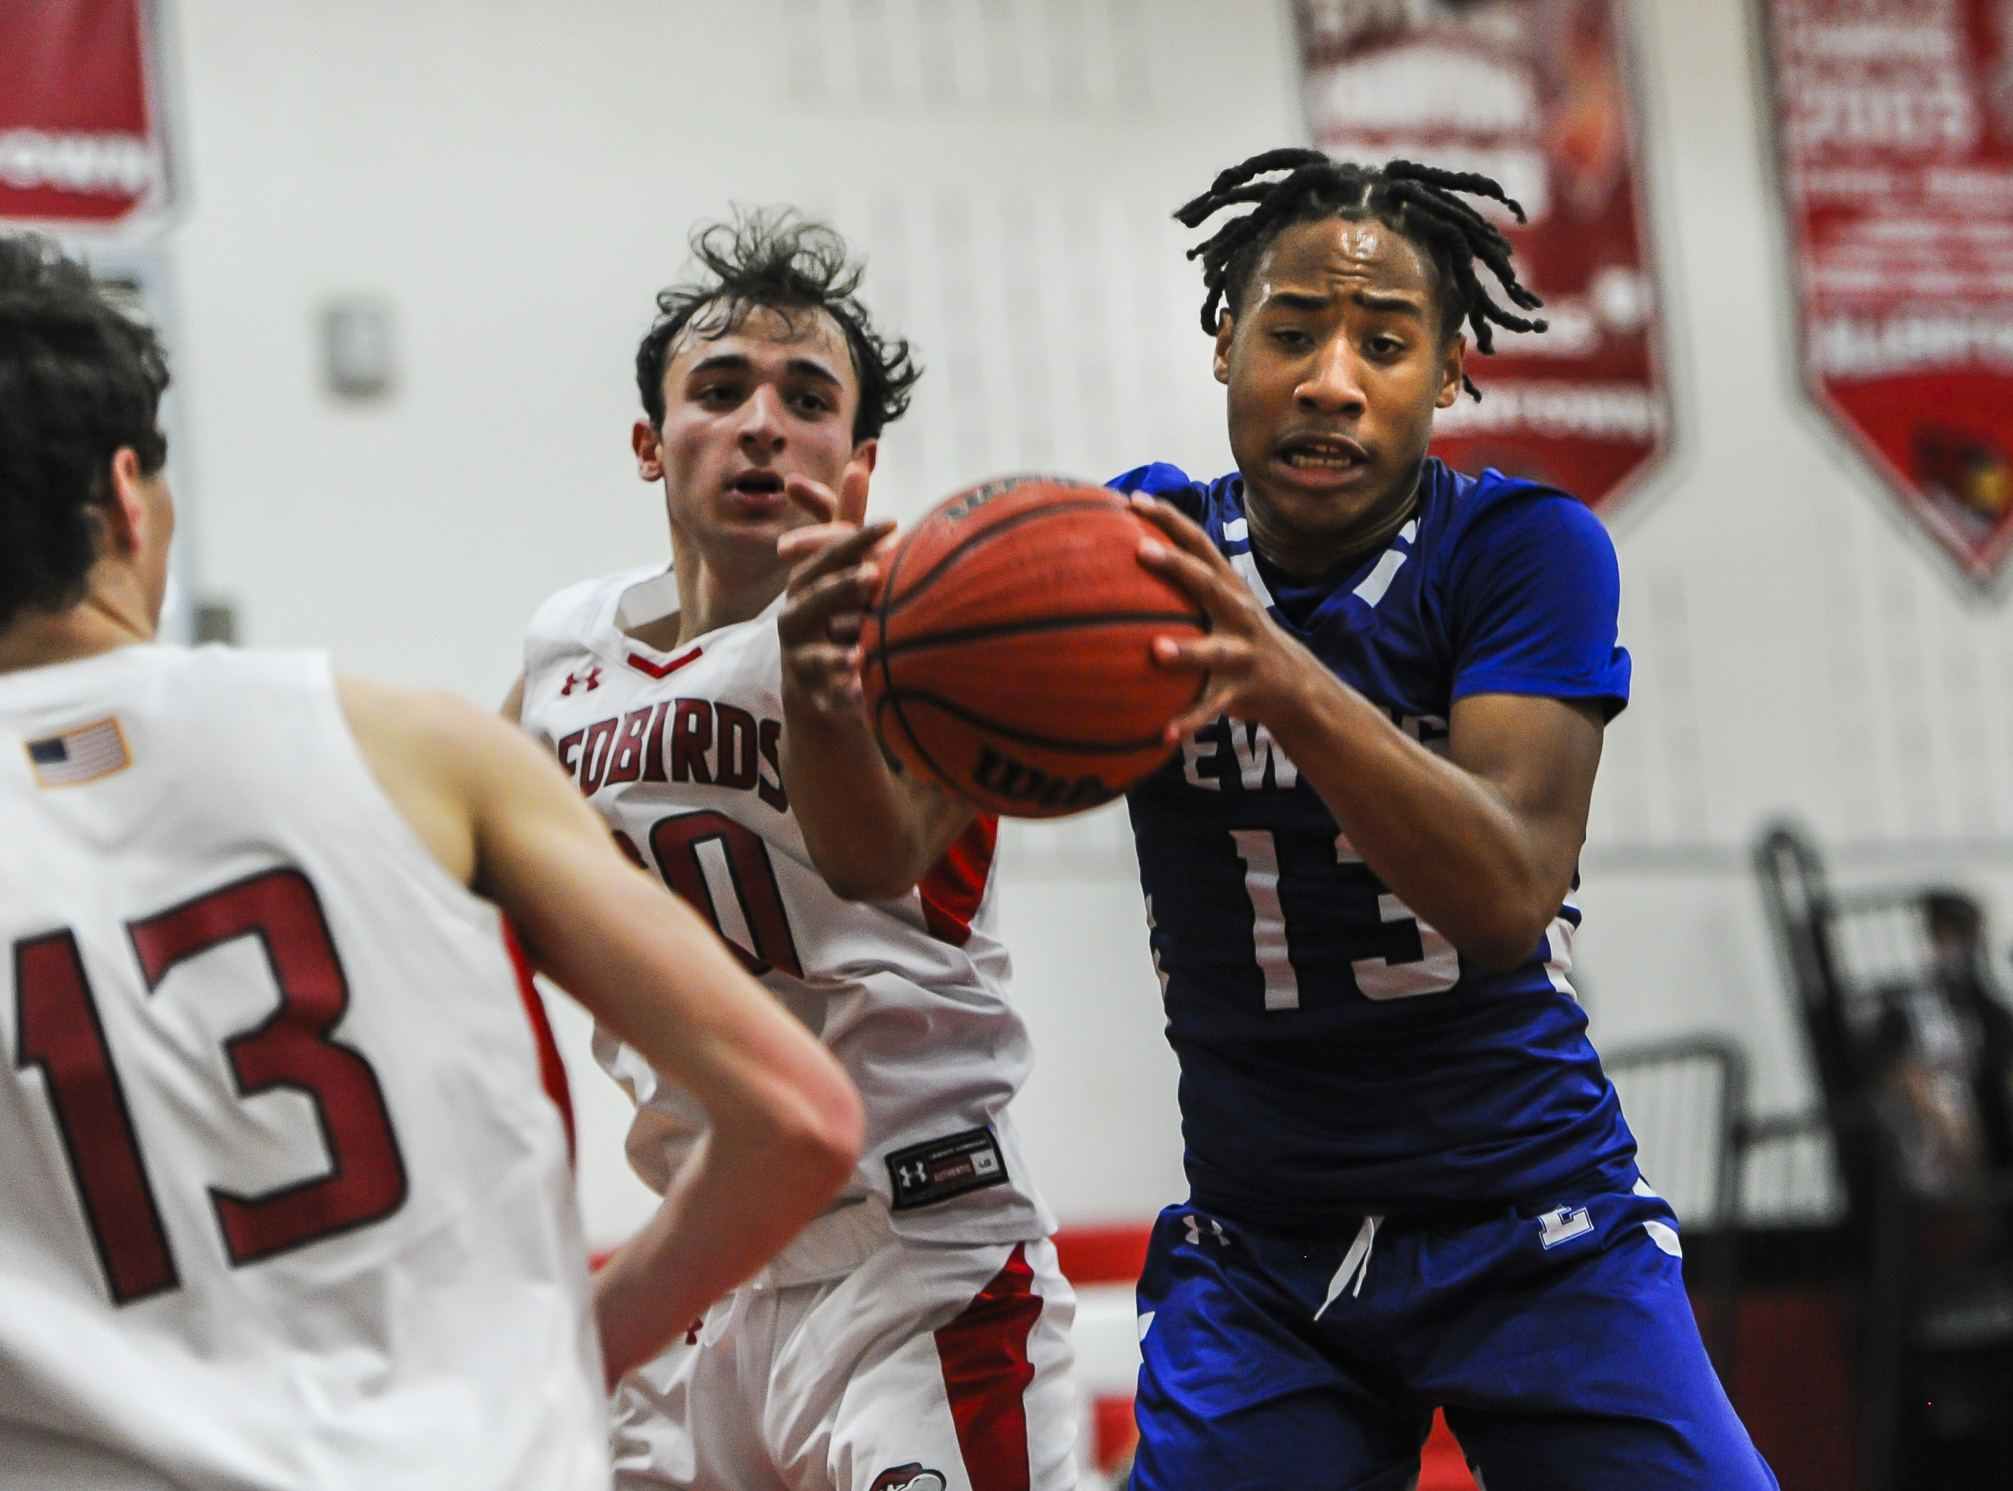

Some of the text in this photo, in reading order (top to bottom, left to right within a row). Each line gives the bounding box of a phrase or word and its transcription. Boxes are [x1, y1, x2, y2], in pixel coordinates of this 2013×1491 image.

[558, 697, 789, 814] EDBIRDS
[612, 808, 805, 980] 0
[1228, 828, 1460, 1012] 13
[13, 864, 411, 1308] 13
